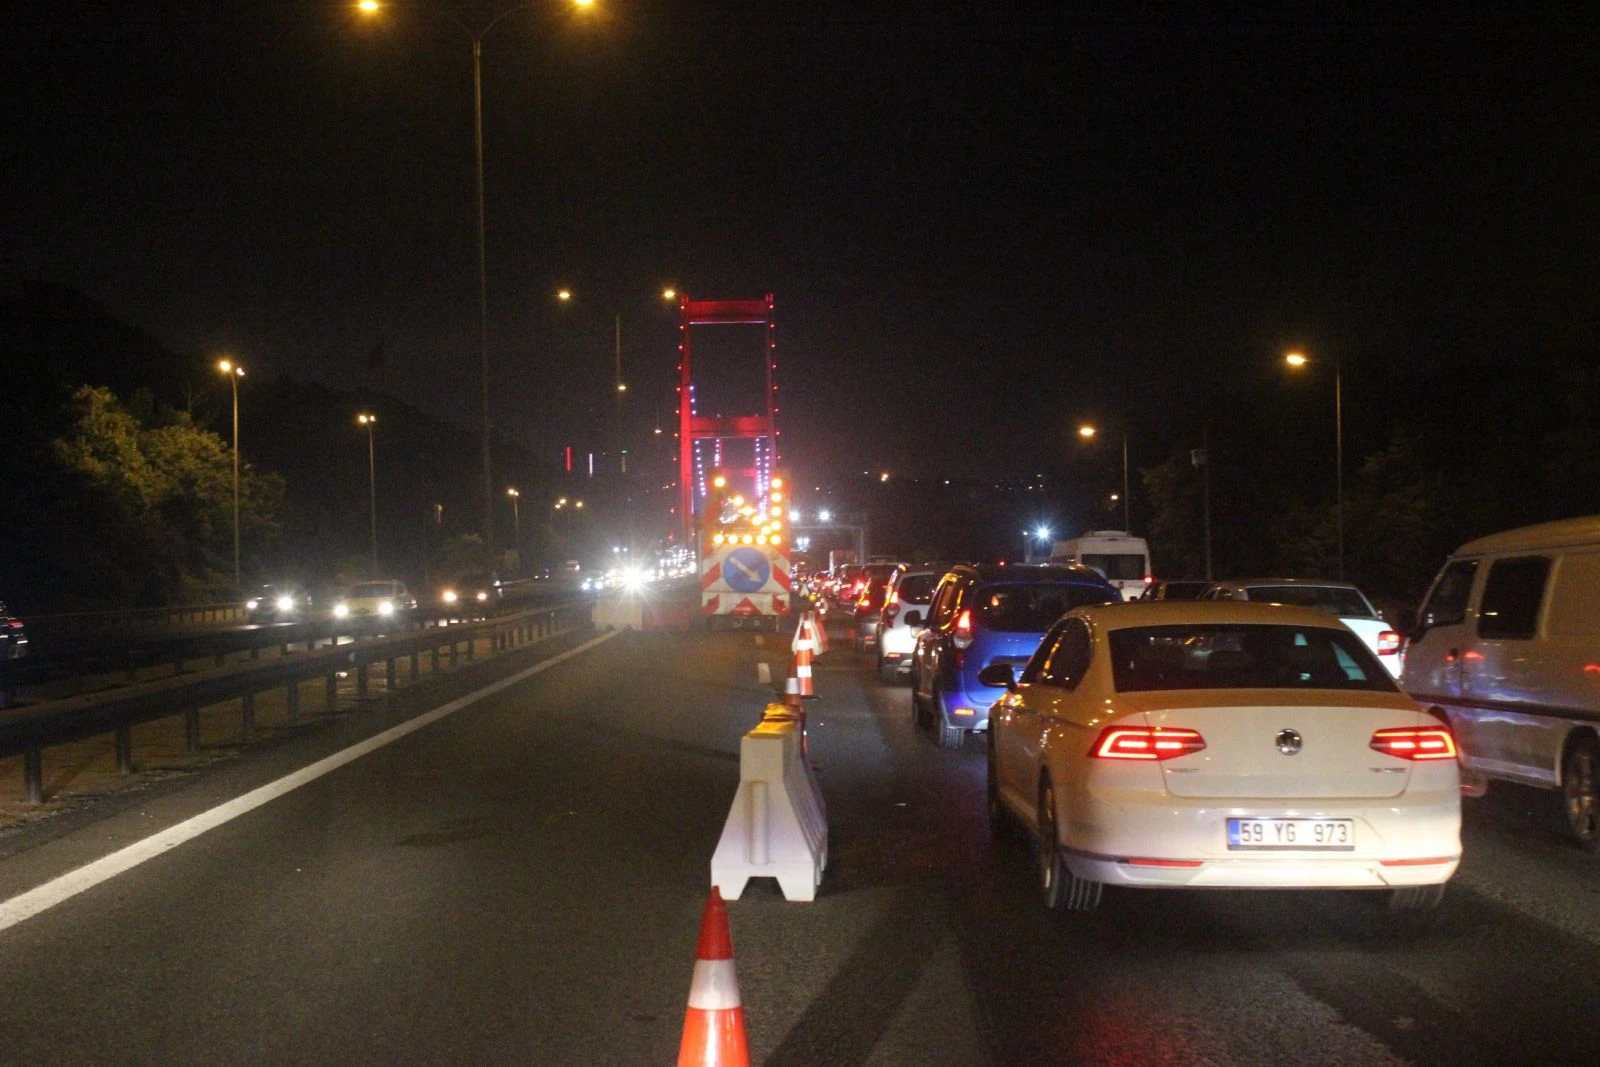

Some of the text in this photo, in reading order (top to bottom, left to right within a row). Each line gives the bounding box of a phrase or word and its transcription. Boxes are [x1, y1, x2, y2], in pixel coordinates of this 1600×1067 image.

[1241, 823, 1347, 843] 59 YG 973
